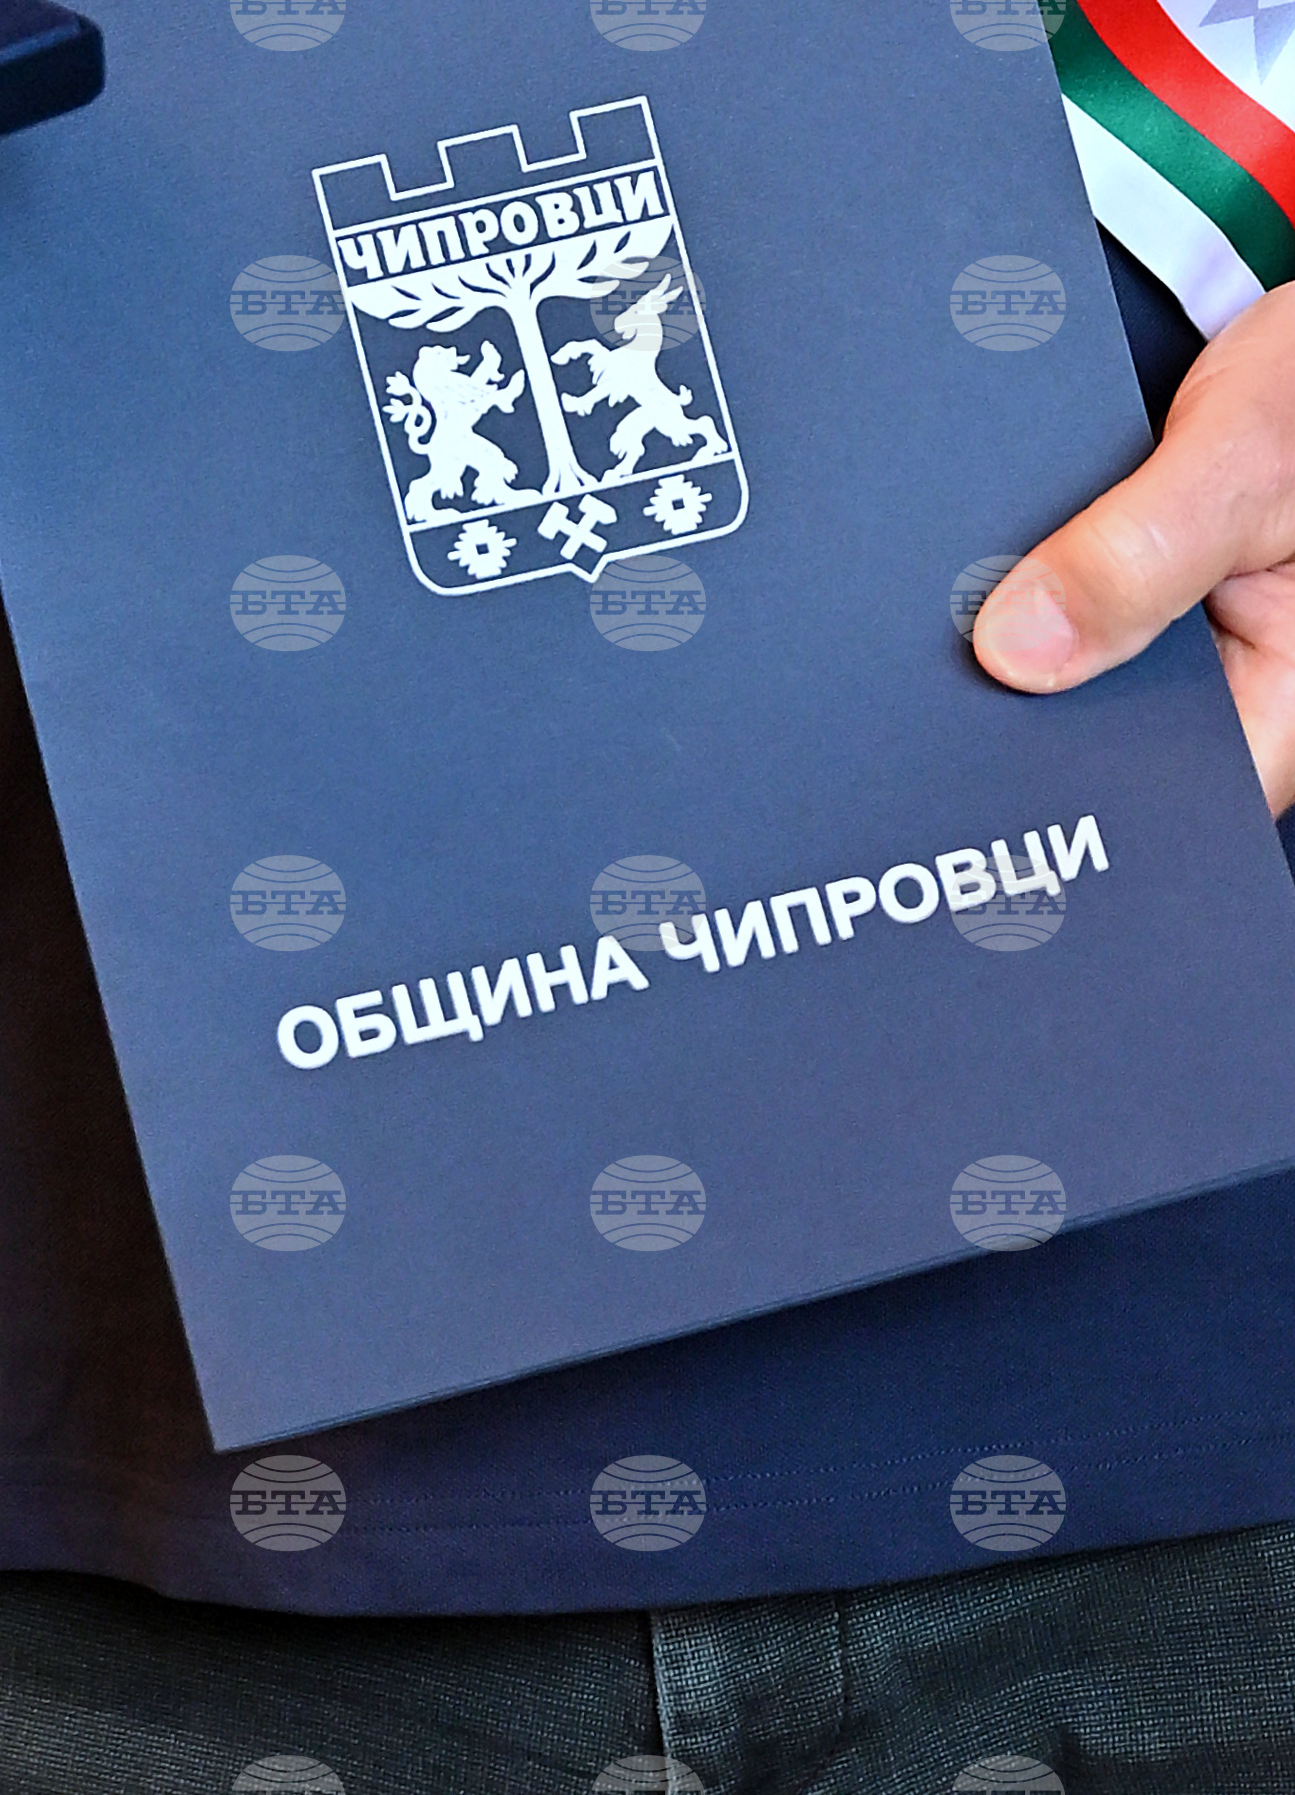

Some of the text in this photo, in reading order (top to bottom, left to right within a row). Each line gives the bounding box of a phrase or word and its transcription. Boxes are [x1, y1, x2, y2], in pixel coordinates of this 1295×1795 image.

[337, 170, 667, 282] ЧИПРОВЦИ
[277, 815, 1111, 1070] ОБЩИНА ЧИПРОВЦИ
